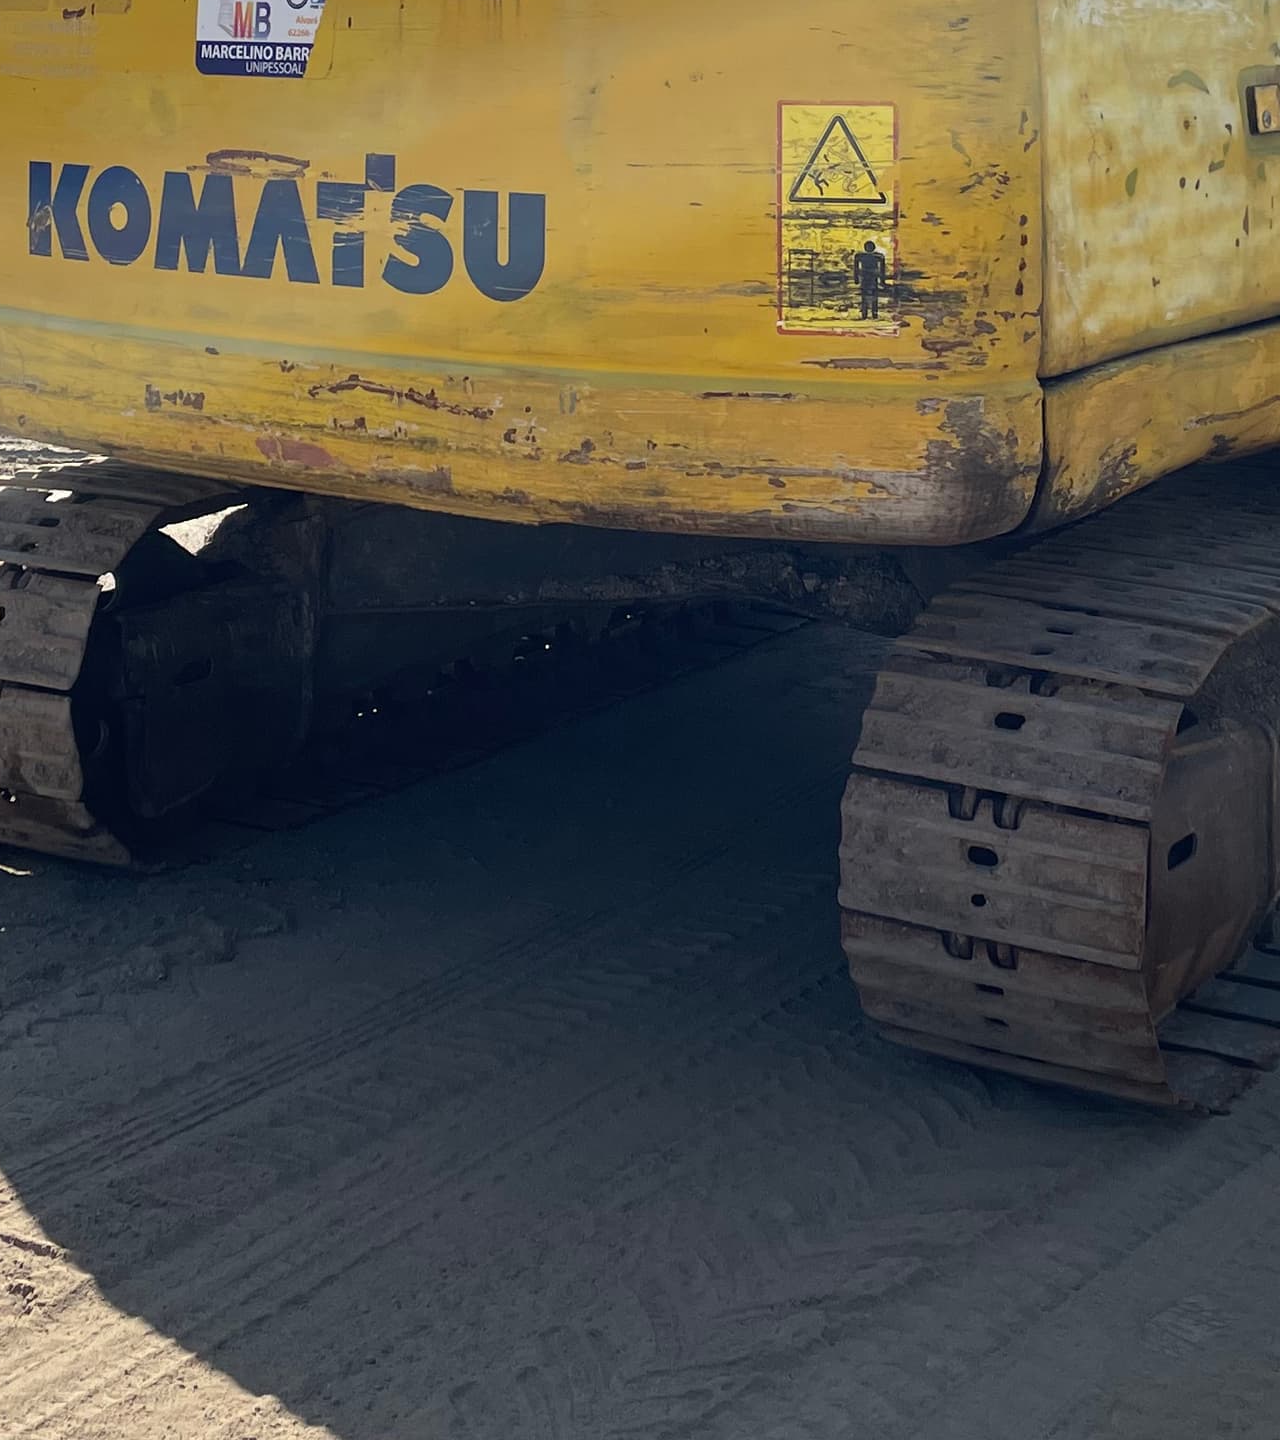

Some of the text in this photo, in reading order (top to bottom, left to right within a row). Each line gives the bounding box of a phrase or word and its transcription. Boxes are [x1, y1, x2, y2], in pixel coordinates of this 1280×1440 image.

[233, 1, 271, 40] MB
[201, 44, 310, 61] MARCELINO BARR
[245, 61, 303, 74] UNIPESSOAL
[28, 153, 547, 302] KOMATSU
